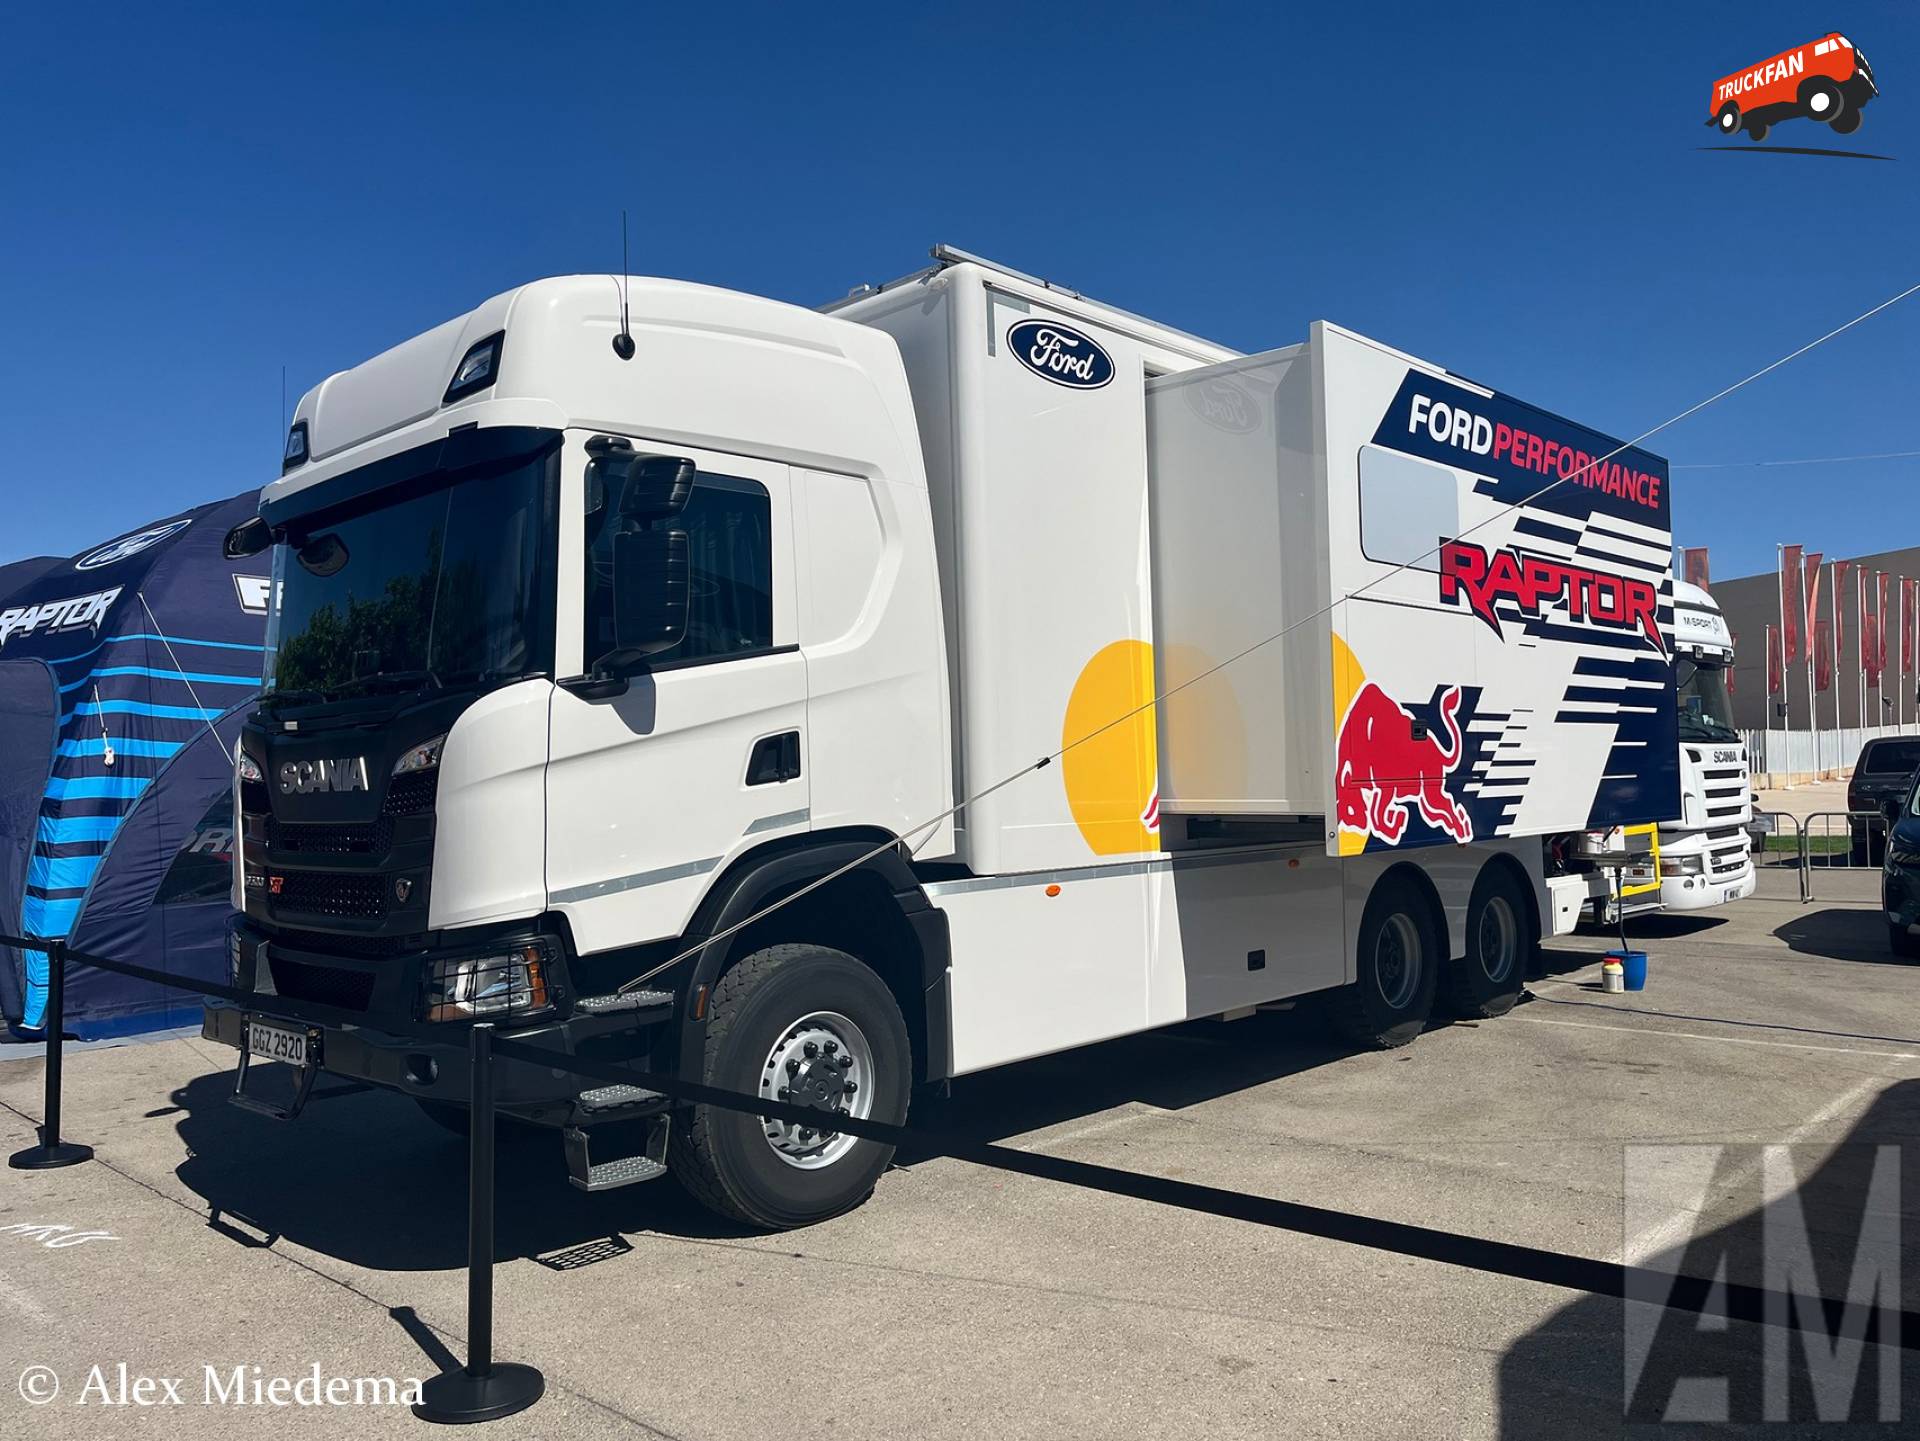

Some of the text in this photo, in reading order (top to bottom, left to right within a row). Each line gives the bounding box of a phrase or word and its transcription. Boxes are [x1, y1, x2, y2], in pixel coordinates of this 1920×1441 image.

[1030, 328, 1094, 380] Ford
[1408, 394, 1660, 509] FORD PERFORMANCE
[0, 585, 124, 647] RAPTOR
[1439, 538, 1669, 663] RAPTOR
[280, 756, 369, 795] SCANIA
[1713, 750, 1737, 763] SCANIA
[274, 1032, 303, 1061] 2920
